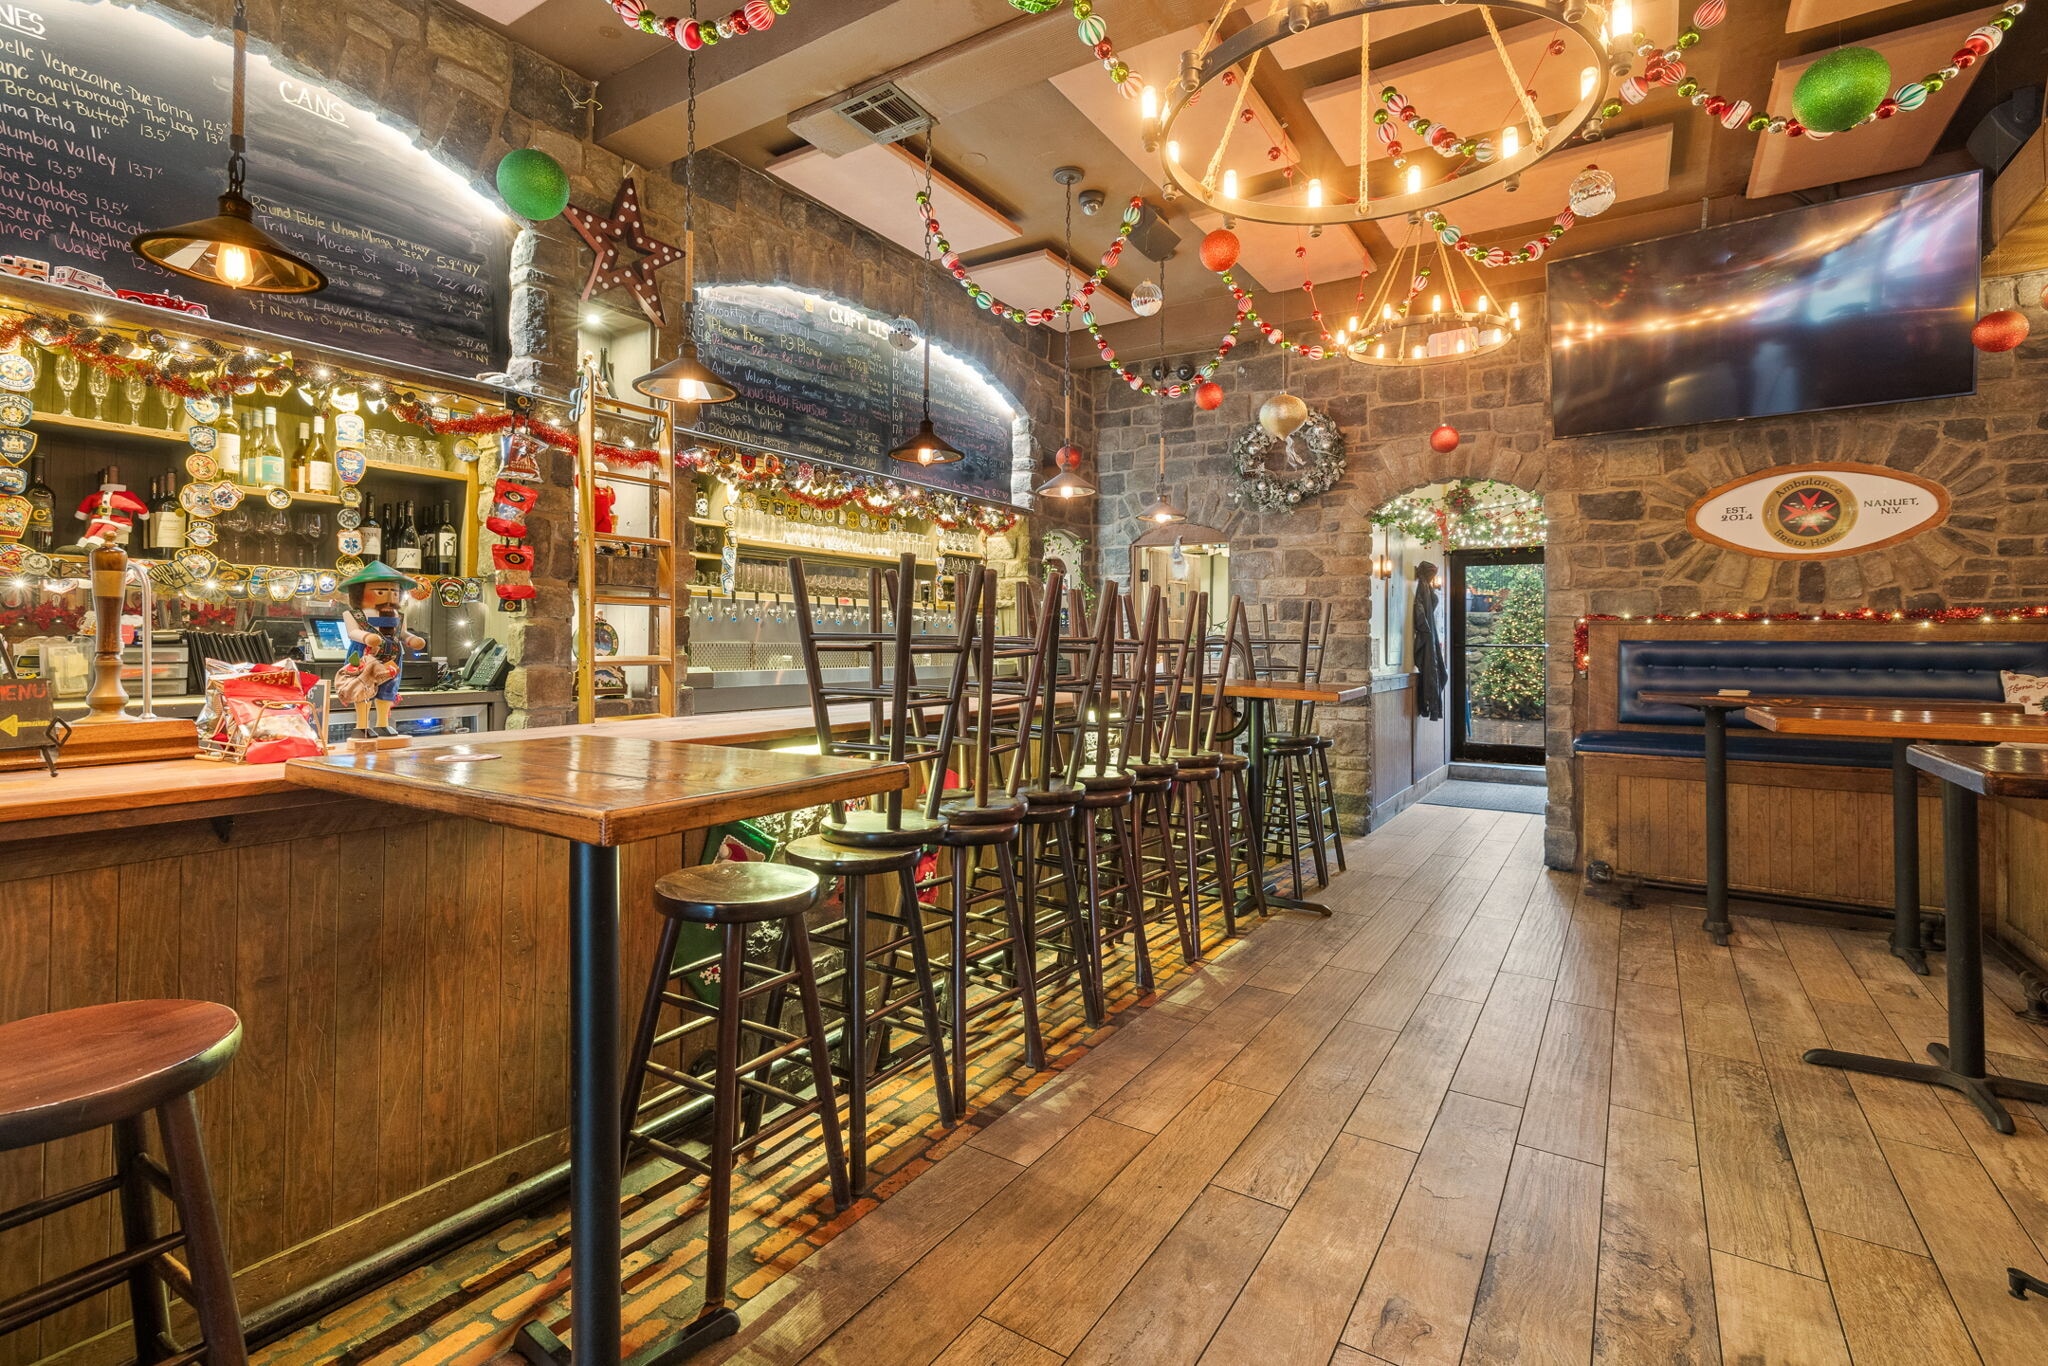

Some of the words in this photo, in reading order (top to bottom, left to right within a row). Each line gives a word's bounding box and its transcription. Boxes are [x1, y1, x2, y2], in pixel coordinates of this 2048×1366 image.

[72, 100, 130, 127] Butter
[280, 80, 346, 122] CANS
[30, 105, 75, 133] Perla
[64, 139, 117, 175] Valley
[24, 172, 88, 205] Dobbes
[54, 235, 109, 262] Water
[829, 306, 867, 330] CRAFT
[867, 317, 890, 341] LIS
[1775, 477, 1844, 497] Ambulance
[1720, 513, 1754, 521] 2014
[1725, 506, 1748, 514] EST.
[1774, 528, 1807, 547] Brew
